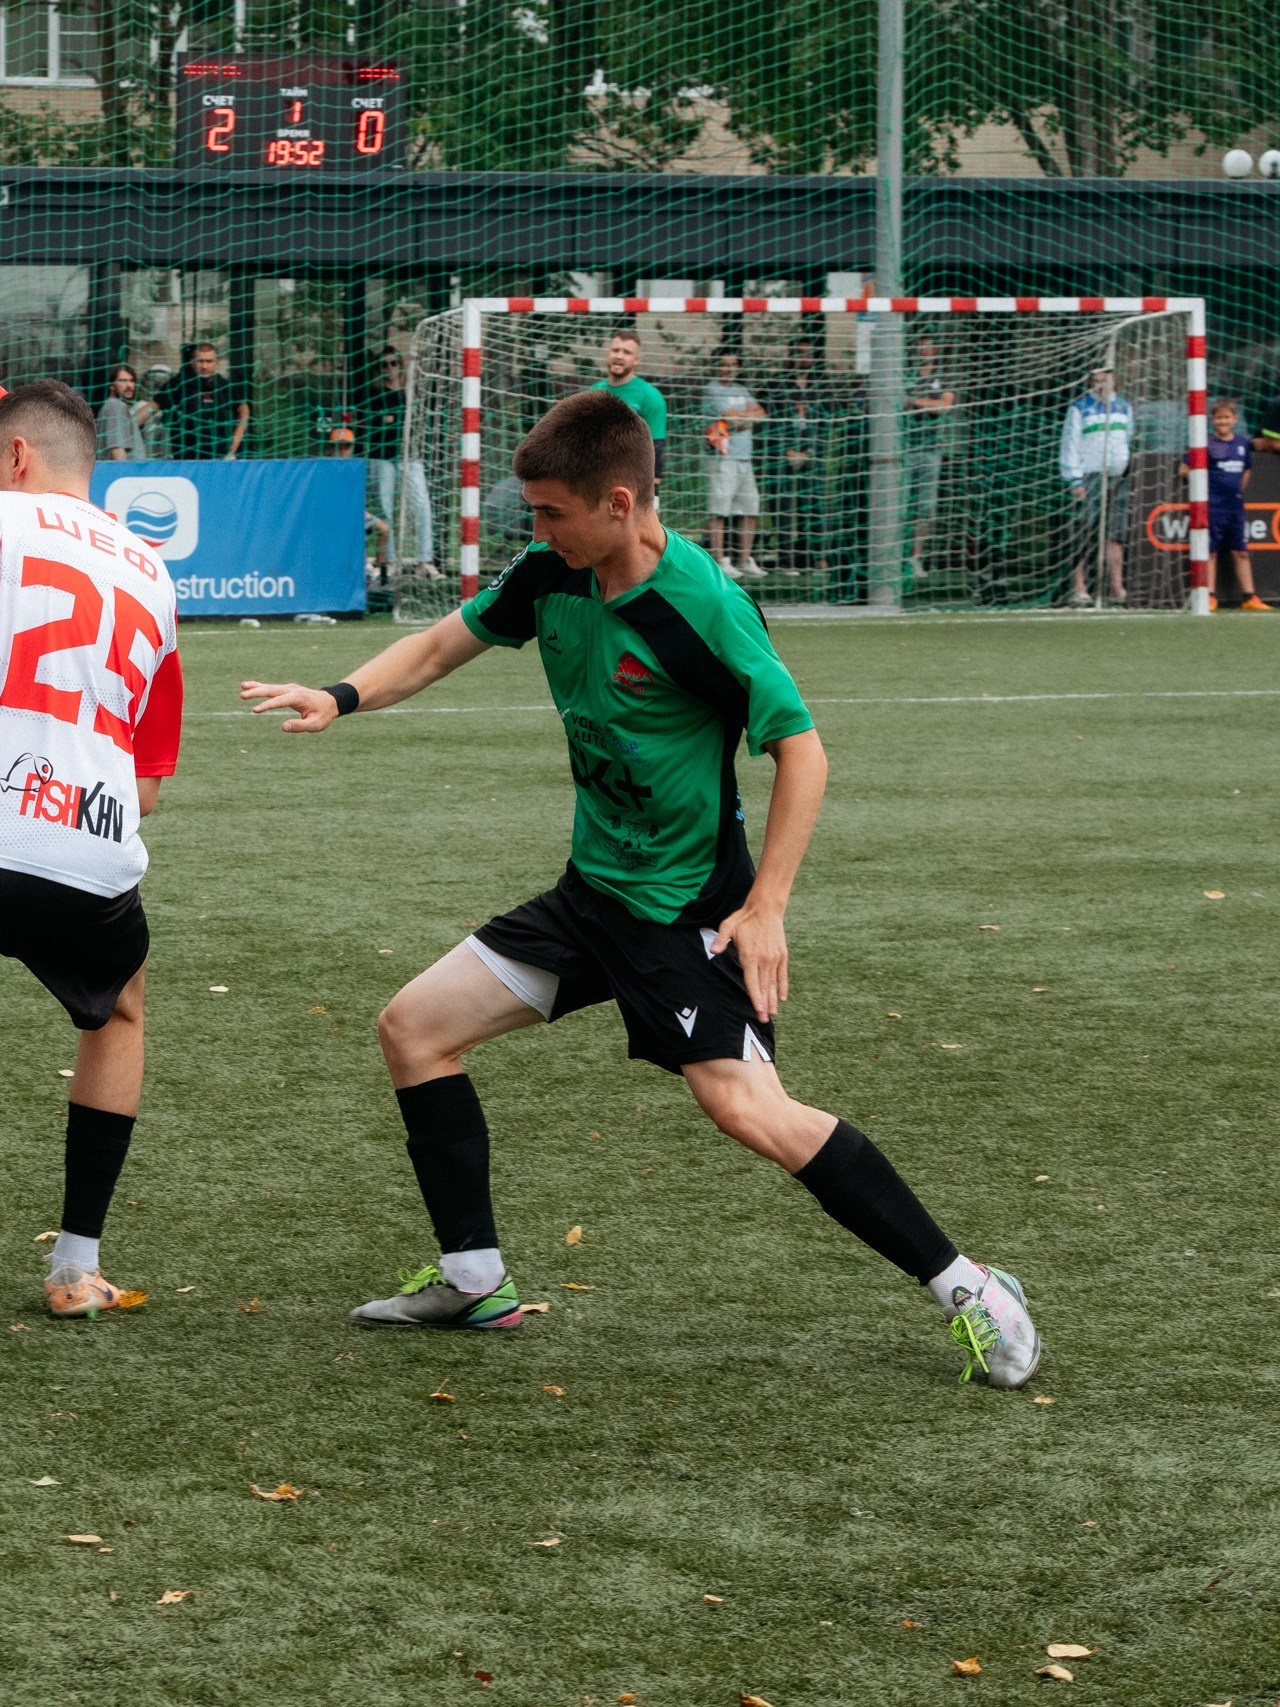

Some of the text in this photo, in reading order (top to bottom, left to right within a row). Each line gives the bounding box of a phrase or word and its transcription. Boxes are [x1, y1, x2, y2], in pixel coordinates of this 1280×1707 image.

[202, 95, 235, 106] СЧЕТ
[280, 87, 308, 97] ТАЙМ
[352, 98, 384, 109] СЧЕТ
[292, 101, 302, 123] 1
[207, 108, 235, 151] 2
[277, 129, 310, 138] ВРЕМЯ
[357, 110, 385, 154] 0
[268, 140, 325, 166] 19:52
[36, 507, 158, 582] ШЕФ
[175, 570, 295, 600] struction
